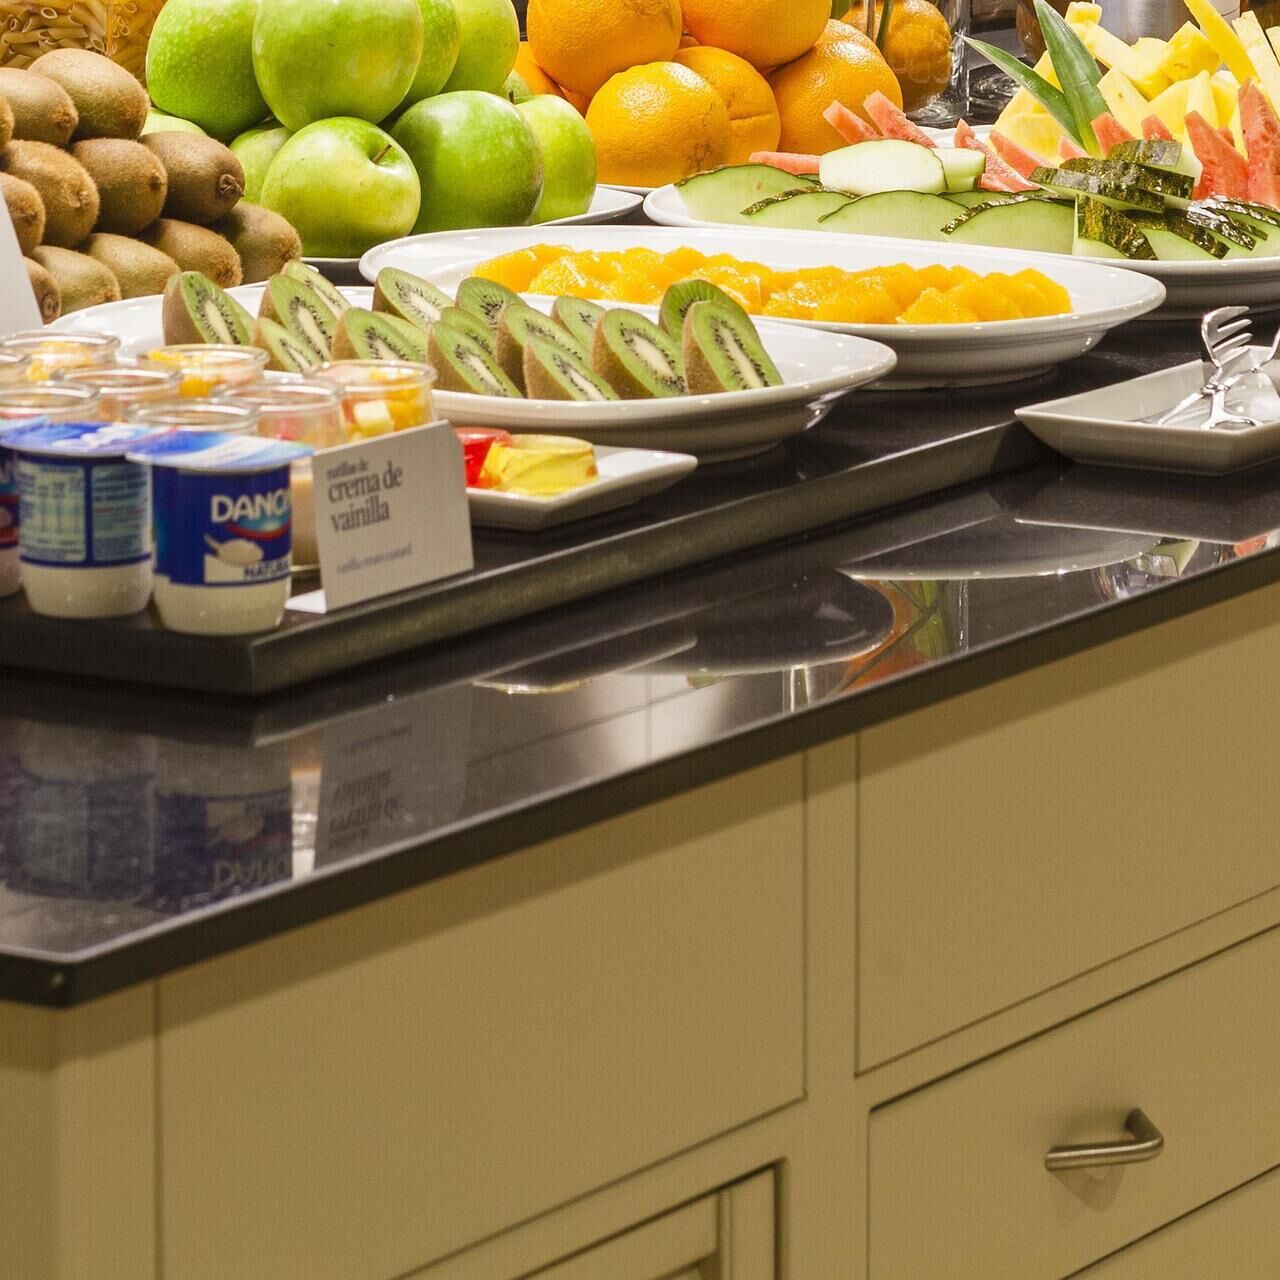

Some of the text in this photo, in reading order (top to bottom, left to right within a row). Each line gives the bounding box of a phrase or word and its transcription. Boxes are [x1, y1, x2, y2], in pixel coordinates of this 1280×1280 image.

[328, 459, 404, 504] crema de
[330, 494, 391, 533] vainilla
